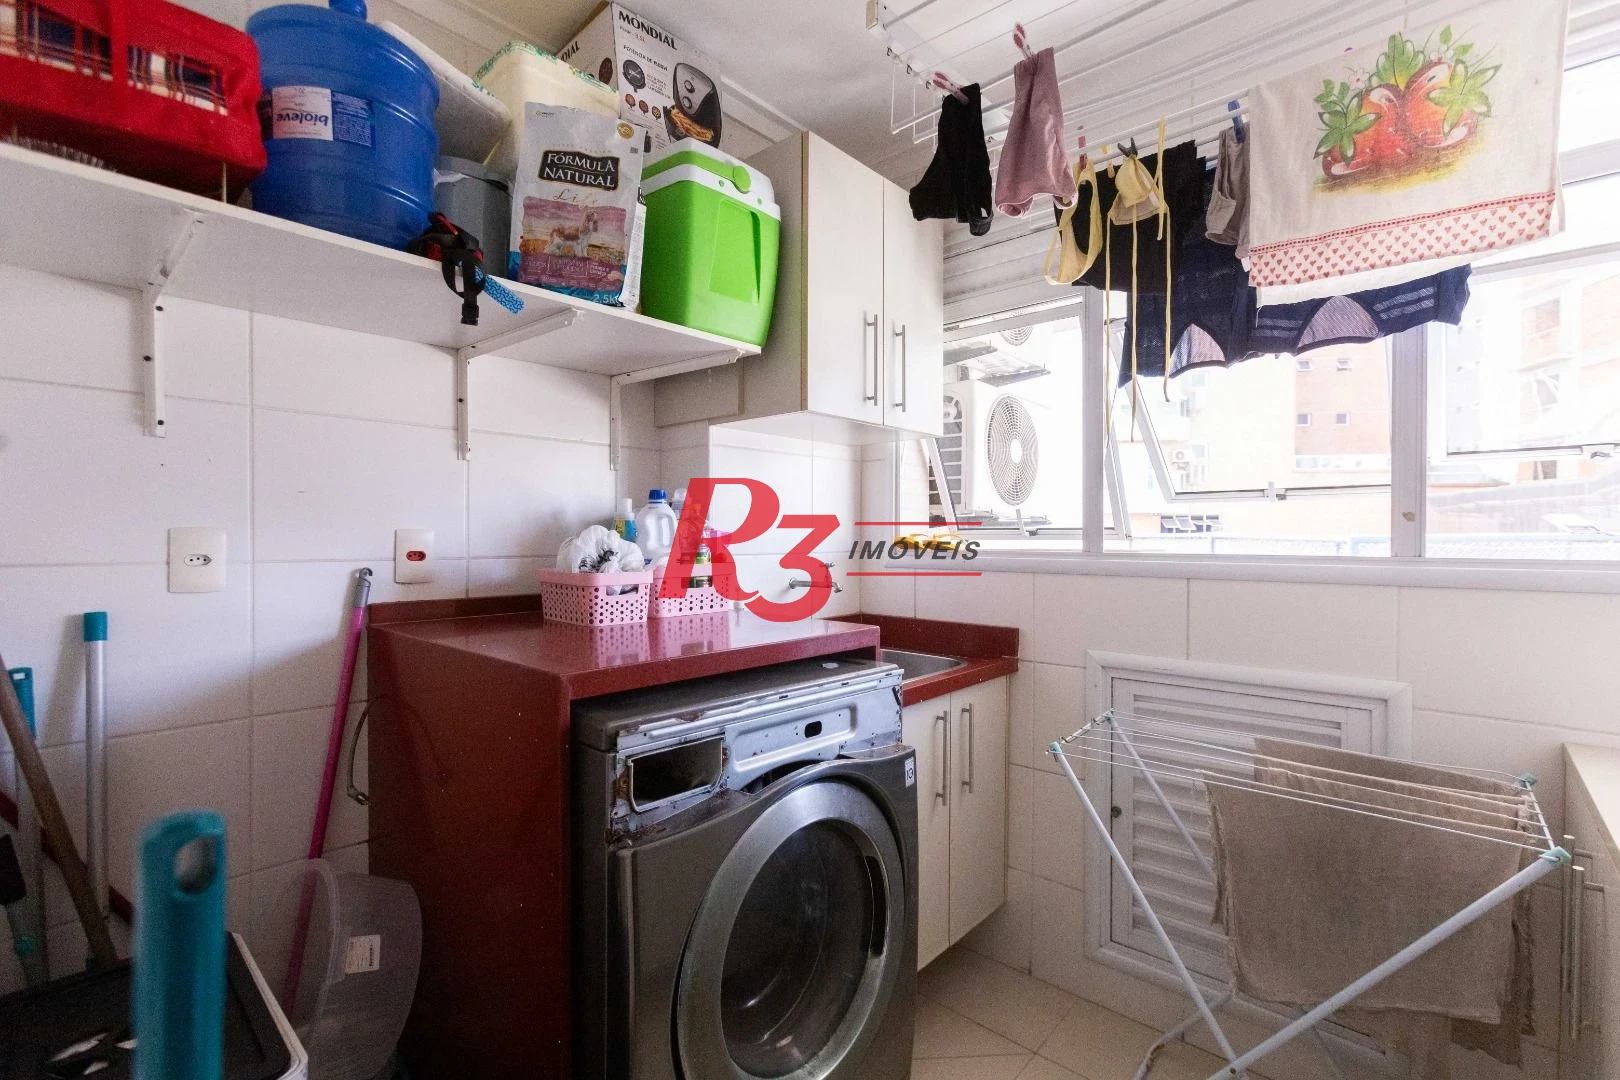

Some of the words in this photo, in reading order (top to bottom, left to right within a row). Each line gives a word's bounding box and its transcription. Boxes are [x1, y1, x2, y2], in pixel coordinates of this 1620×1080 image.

[618, 10, 678, 50] MONDIAL
[561, 41, 580, 62] DIAL
[276, 111, 329, 127] bioleve
[547, 152, 616, 173] FÓRMULA
[543, 166, 615, 188] NATURAL
